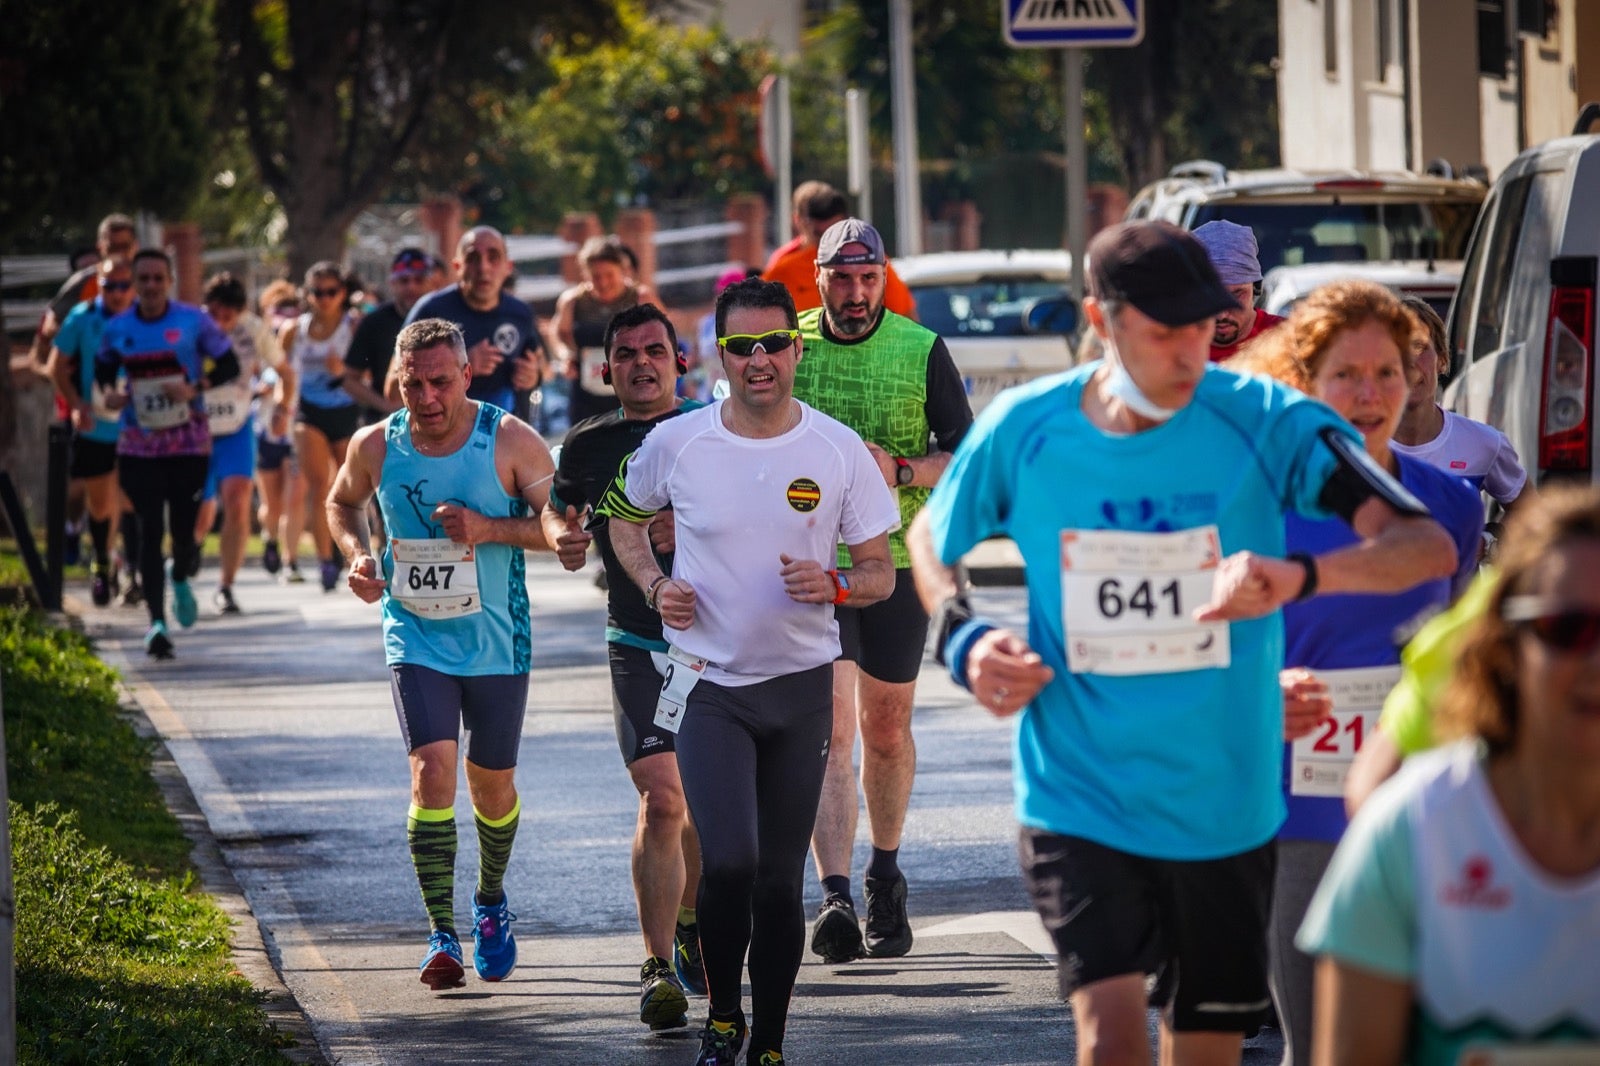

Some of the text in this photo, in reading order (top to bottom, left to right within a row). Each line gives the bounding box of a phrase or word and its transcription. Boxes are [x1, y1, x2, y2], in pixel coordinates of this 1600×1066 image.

[408, 565, 455, 590] 647
[1097, 578, 1182, 619] 641
[662, 663, 675, 692] 9
